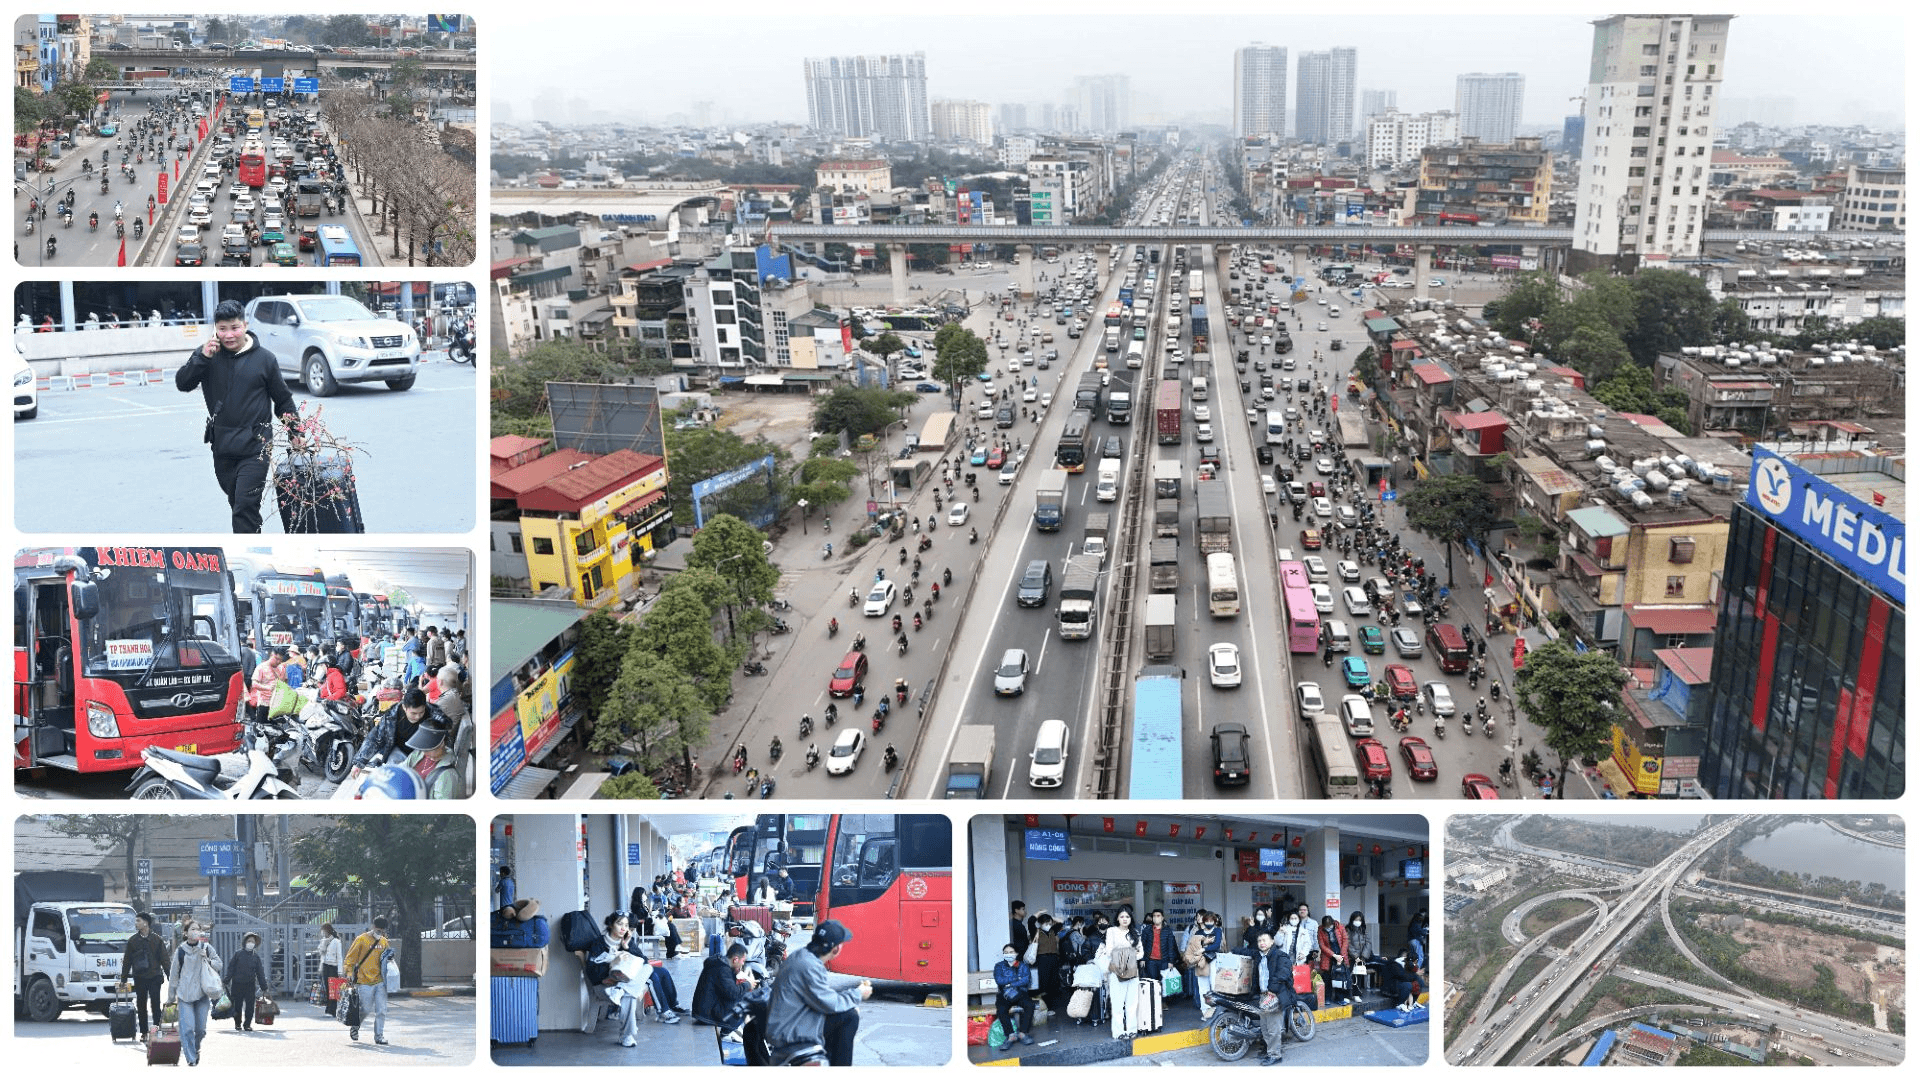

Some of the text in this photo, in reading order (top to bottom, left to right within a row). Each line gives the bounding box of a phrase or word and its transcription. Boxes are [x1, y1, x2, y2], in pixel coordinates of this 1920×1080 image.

[172, 550, 220, 572] OANH
[109, 645, 118, 654] TP
[119, 644, 139, 654] THANH
[212, 853, 220, 866] 1
